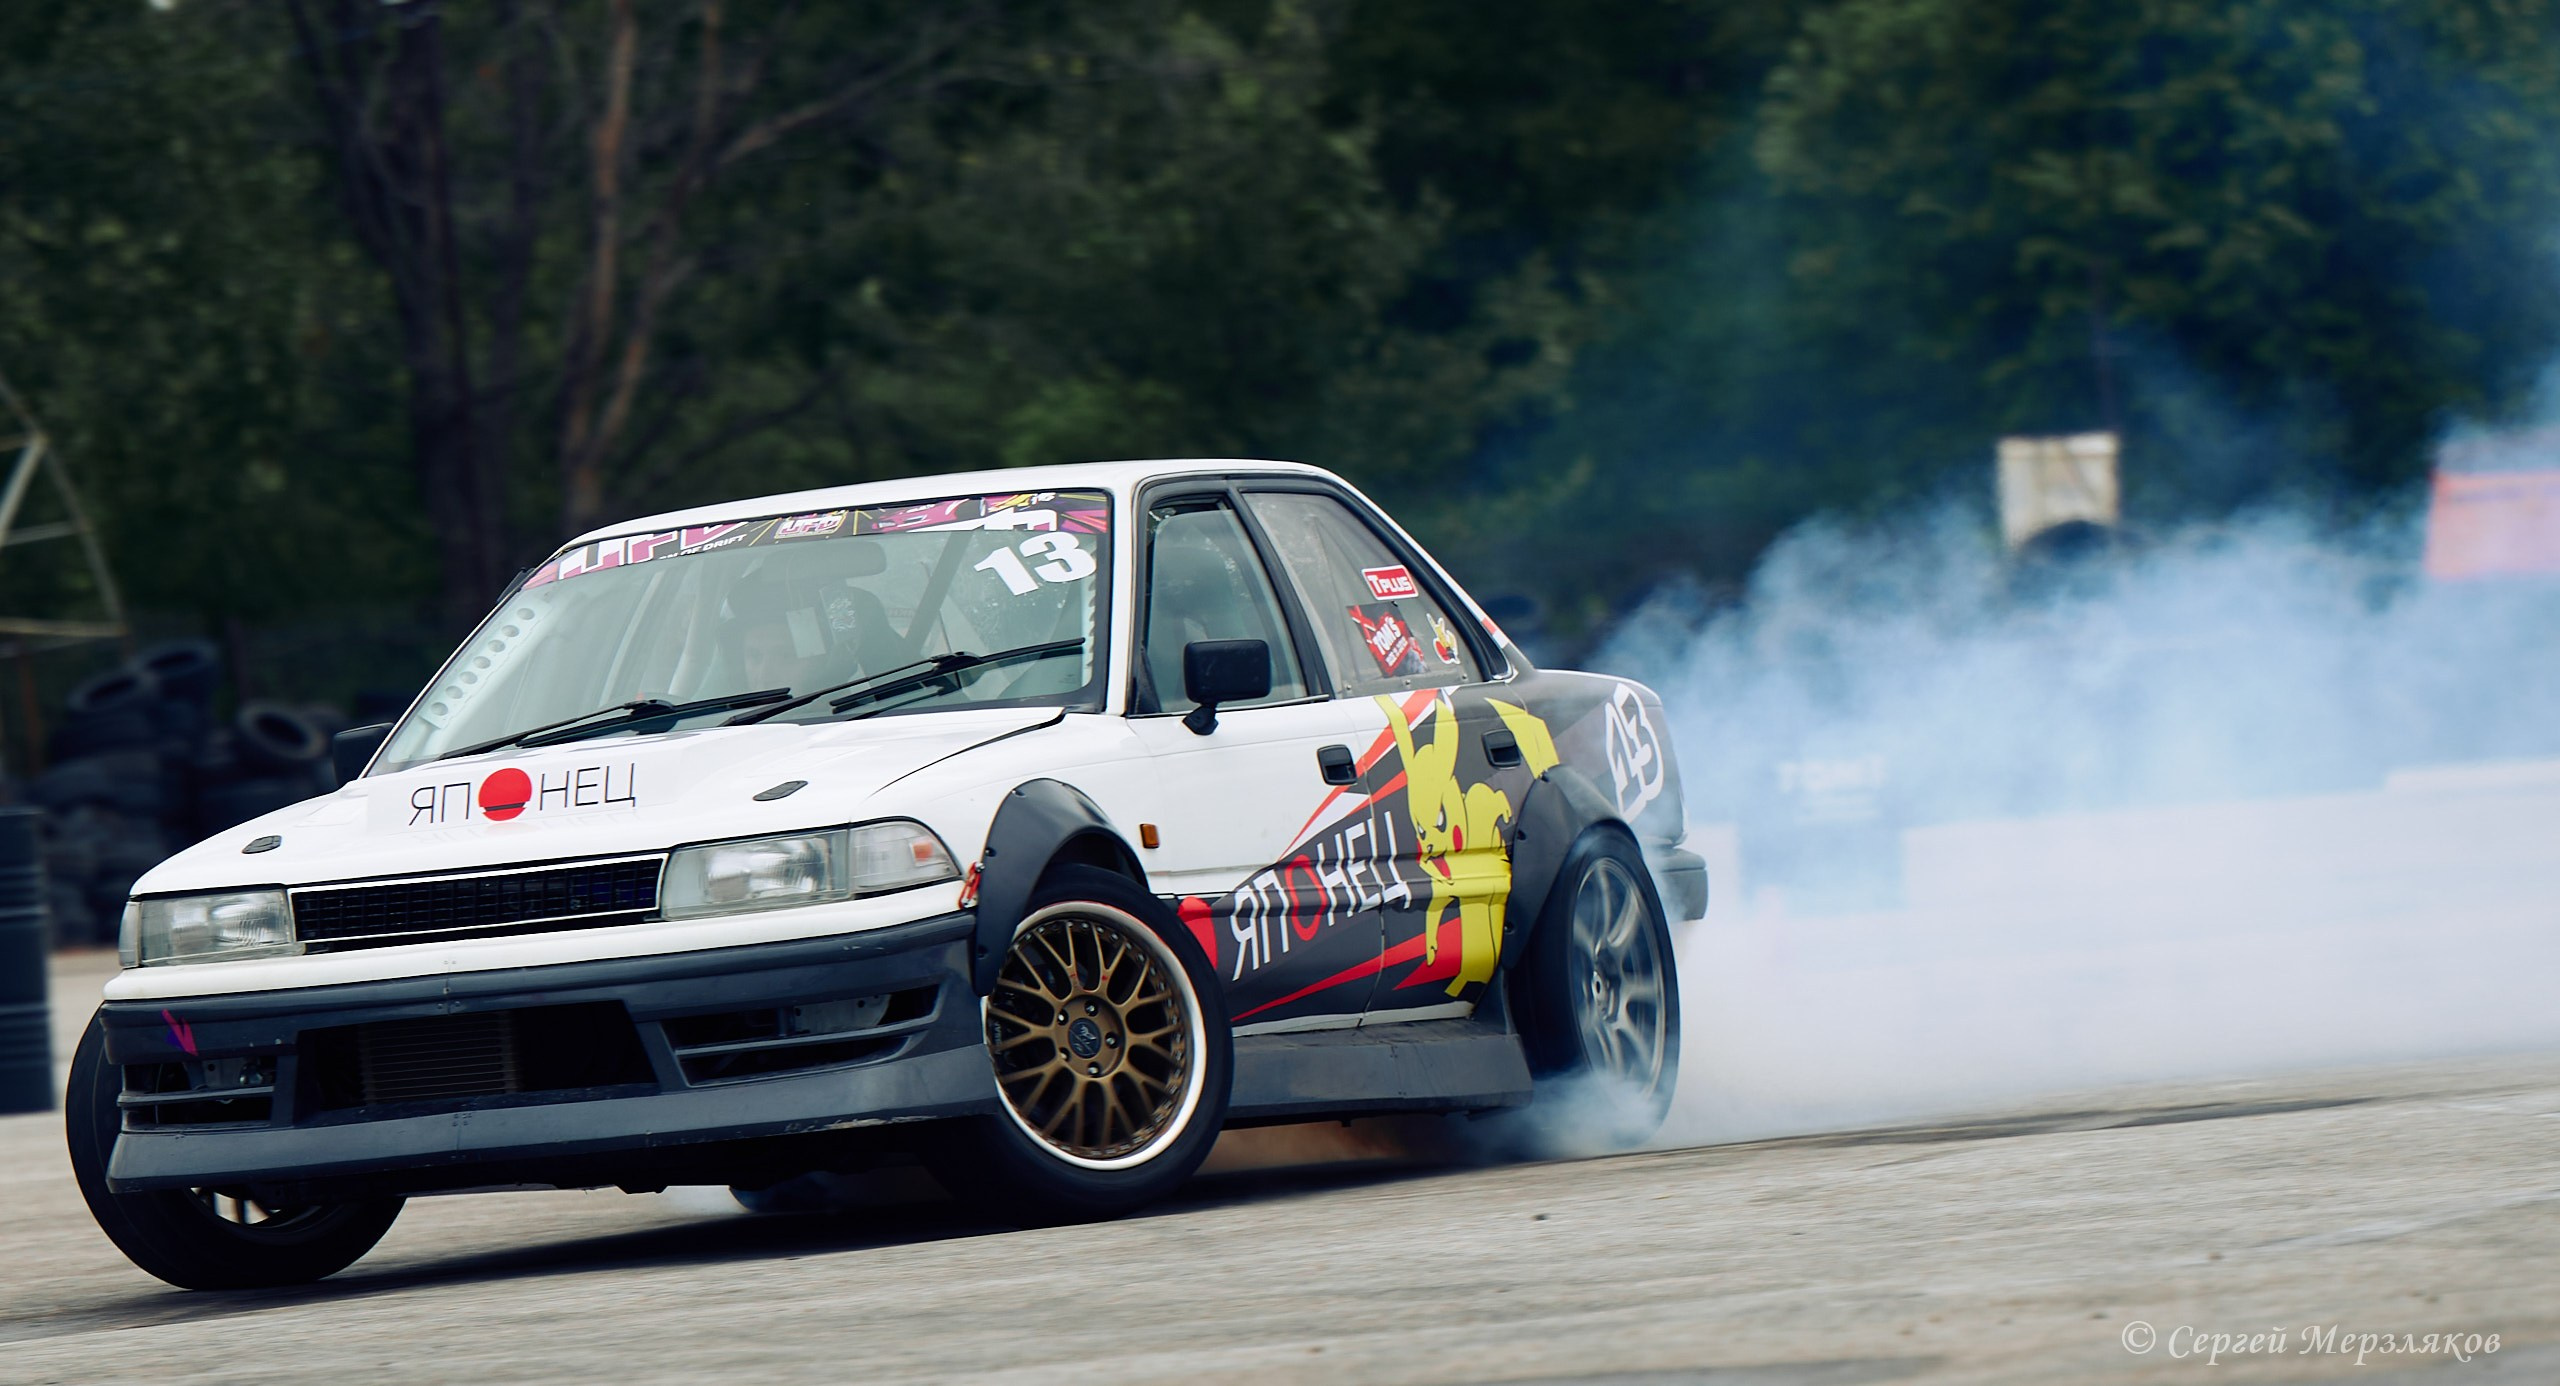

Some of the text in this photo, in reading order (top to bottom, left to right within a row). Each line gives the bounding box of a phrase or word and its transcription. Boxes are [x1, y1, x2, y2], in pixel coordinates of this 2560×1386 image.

[702, 534, 748, 553] DRIFT
[973, 531, 1097, 596] 13
[1605, 682, 1664, 823] 13
[1230, 810, 1412, 982] ЯПОНЕЦ
